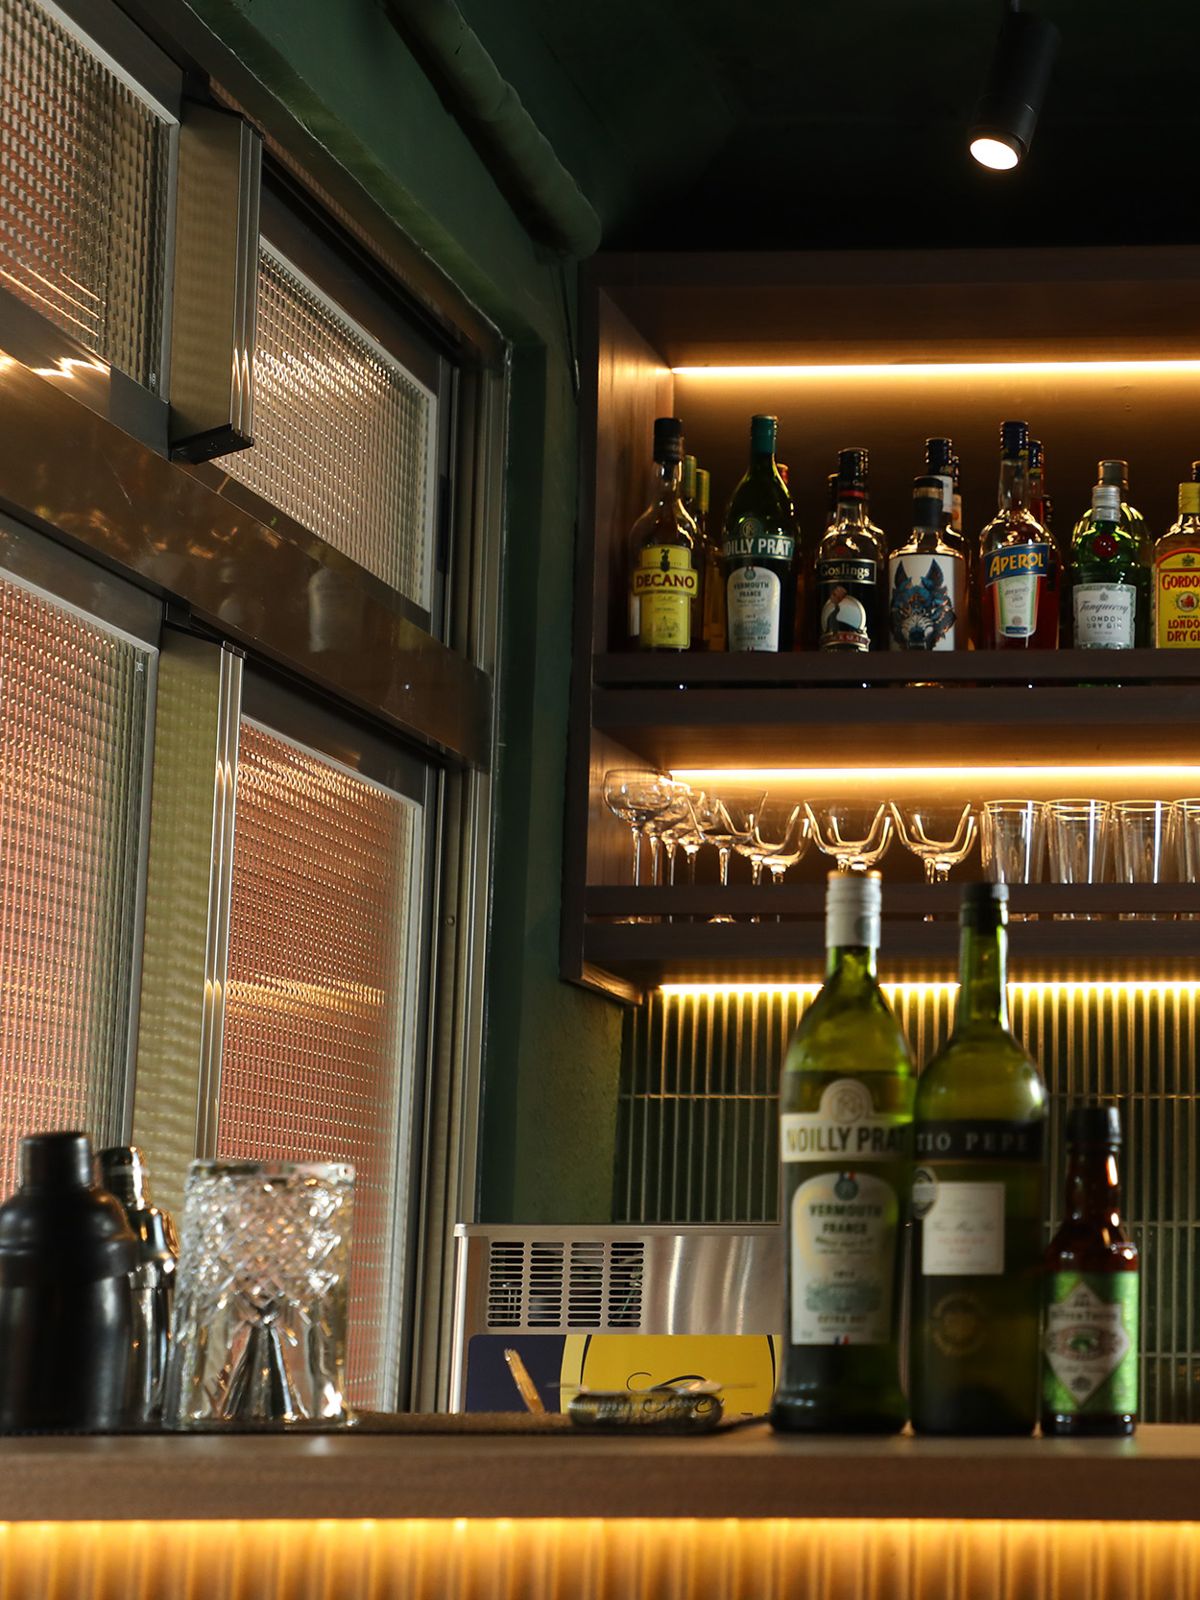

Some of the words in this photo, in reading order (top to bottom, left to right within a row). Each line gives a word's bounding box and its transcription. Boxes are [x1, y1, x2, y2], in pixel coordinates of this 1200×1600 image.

[758, 538, 791, 556] PRAT
[989, 552, 1044, 577] APEROL
[821, 566, 870, 580] Goslings
[636, 574, 695, 588] DECANO
[1080, 600, 1128, 614] Tanqueray
[1167, 631, 1188, 641] DRY
[787, 1126, 850, 1152] NOILLY
[808, 1204, 883, 1218] VERMOUTH
[822, 1222, 867, 1235] FRANCE
